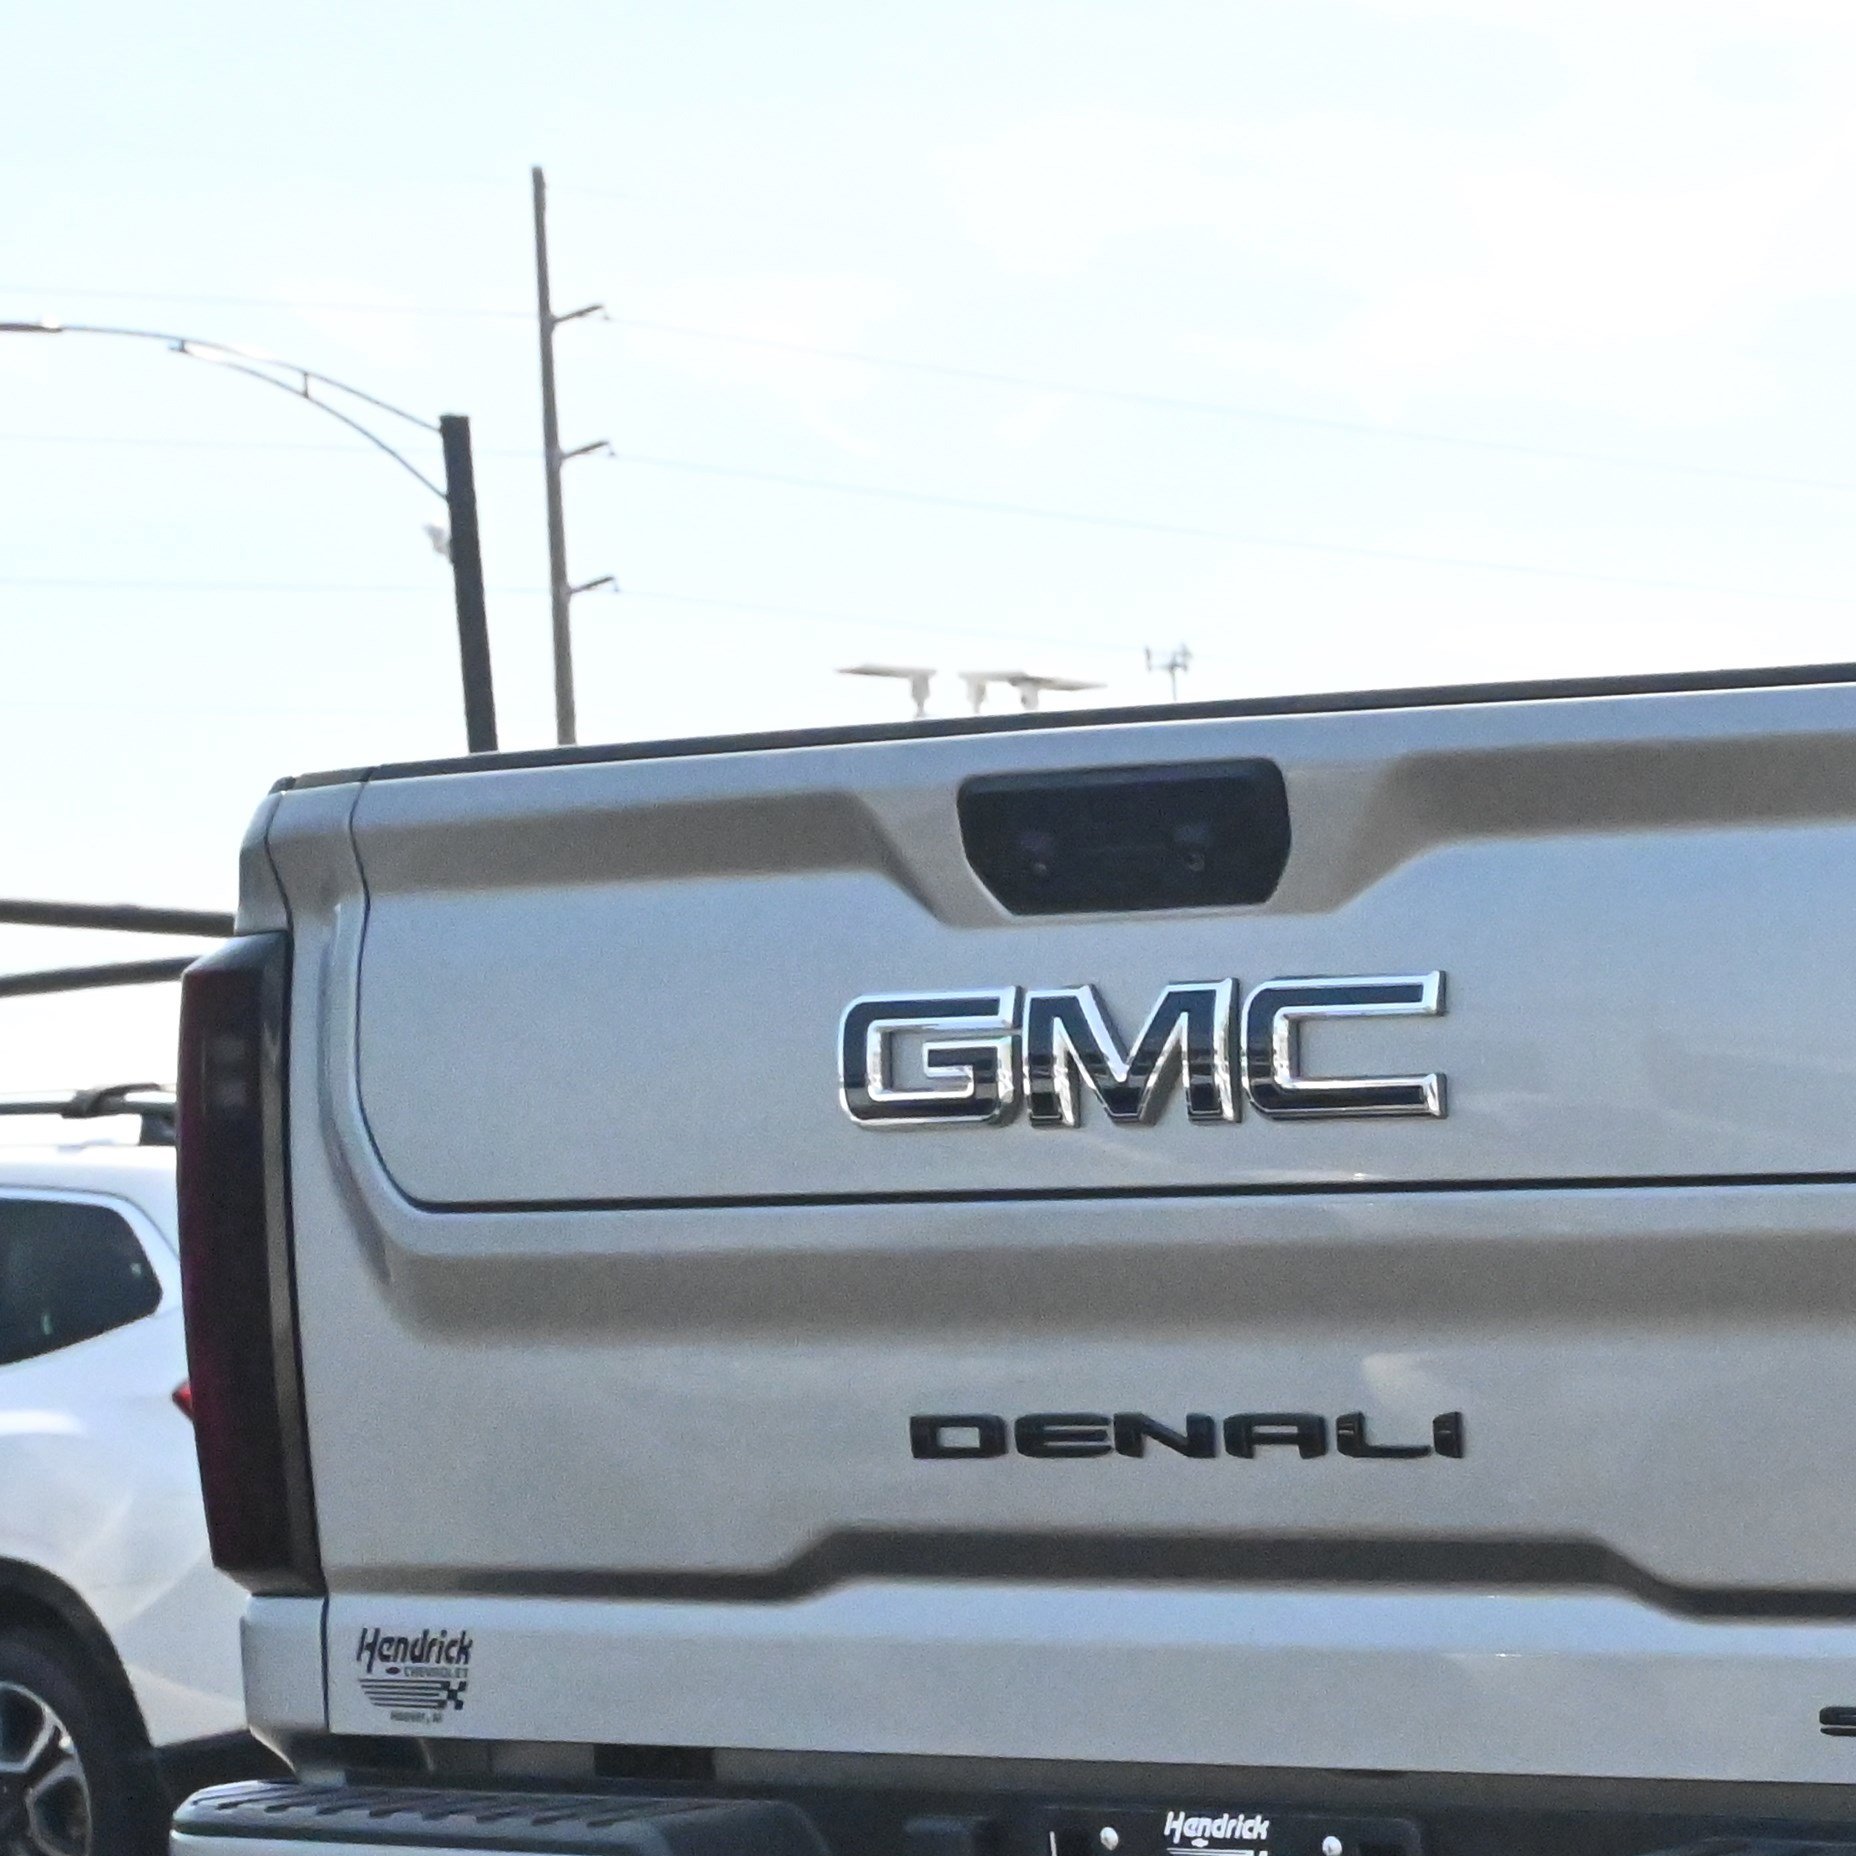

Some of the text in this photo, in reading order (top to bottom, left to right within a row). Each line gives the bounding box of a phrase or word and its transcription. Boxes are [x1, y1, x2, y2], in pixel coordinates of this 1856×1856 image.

[838, 970, 1448, 1128] GMC
[909, 1411, 1465, 1460] DENALI
[356, 1627, 473, 1673] Hendrick
[1163, 1811, 1270, 1844] Hendrick
